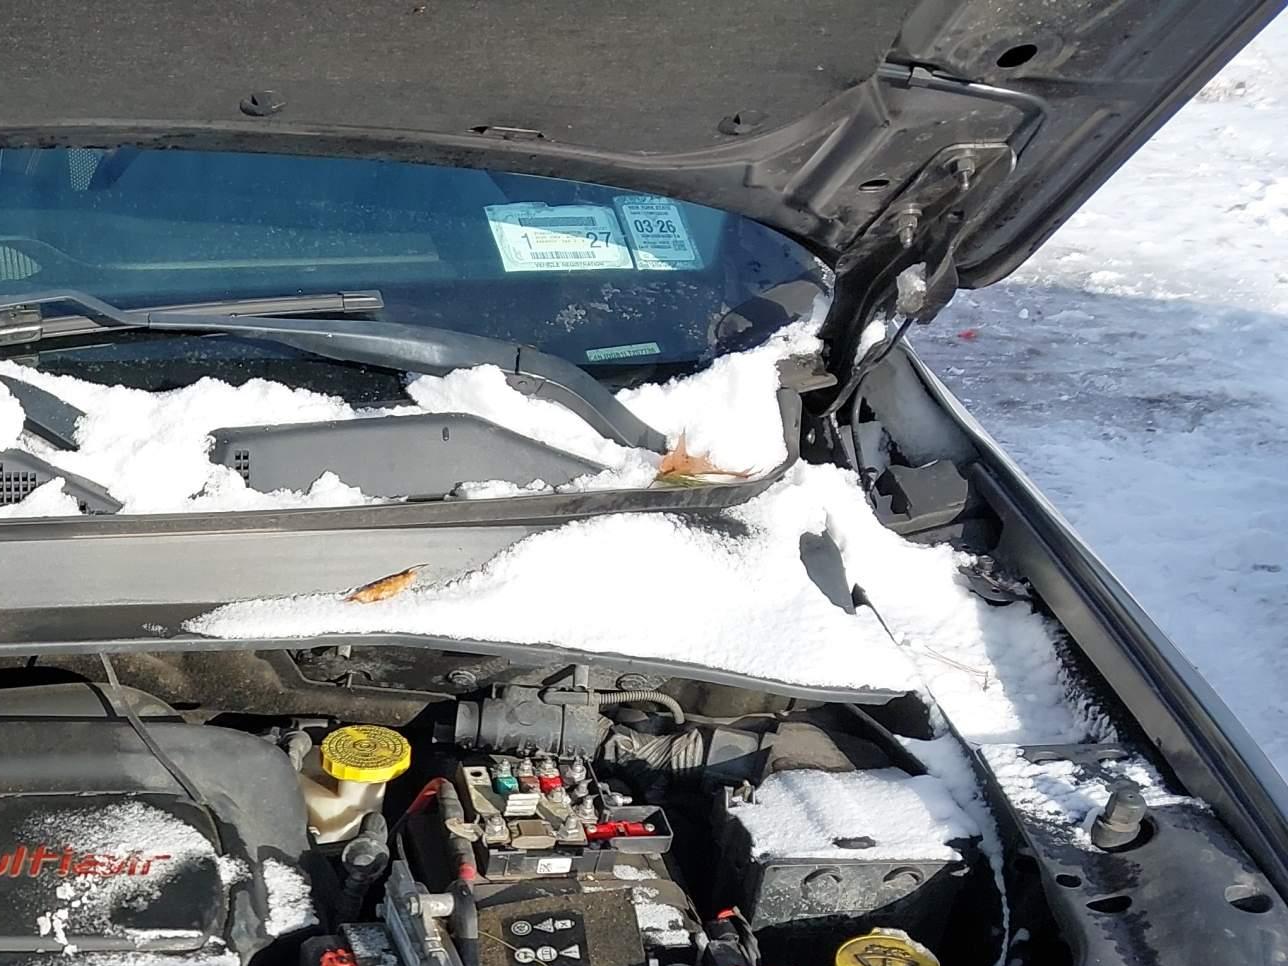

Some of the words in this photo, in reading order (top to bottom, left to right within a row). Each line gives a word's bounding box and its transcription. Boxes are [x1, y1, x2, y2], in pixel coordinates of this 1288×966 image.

[633, 219, 654, 233] 03
[656, 219, 677, 233] 26
[521, 232, 533, 250] 1
[586, 231, 611, 248] 27
